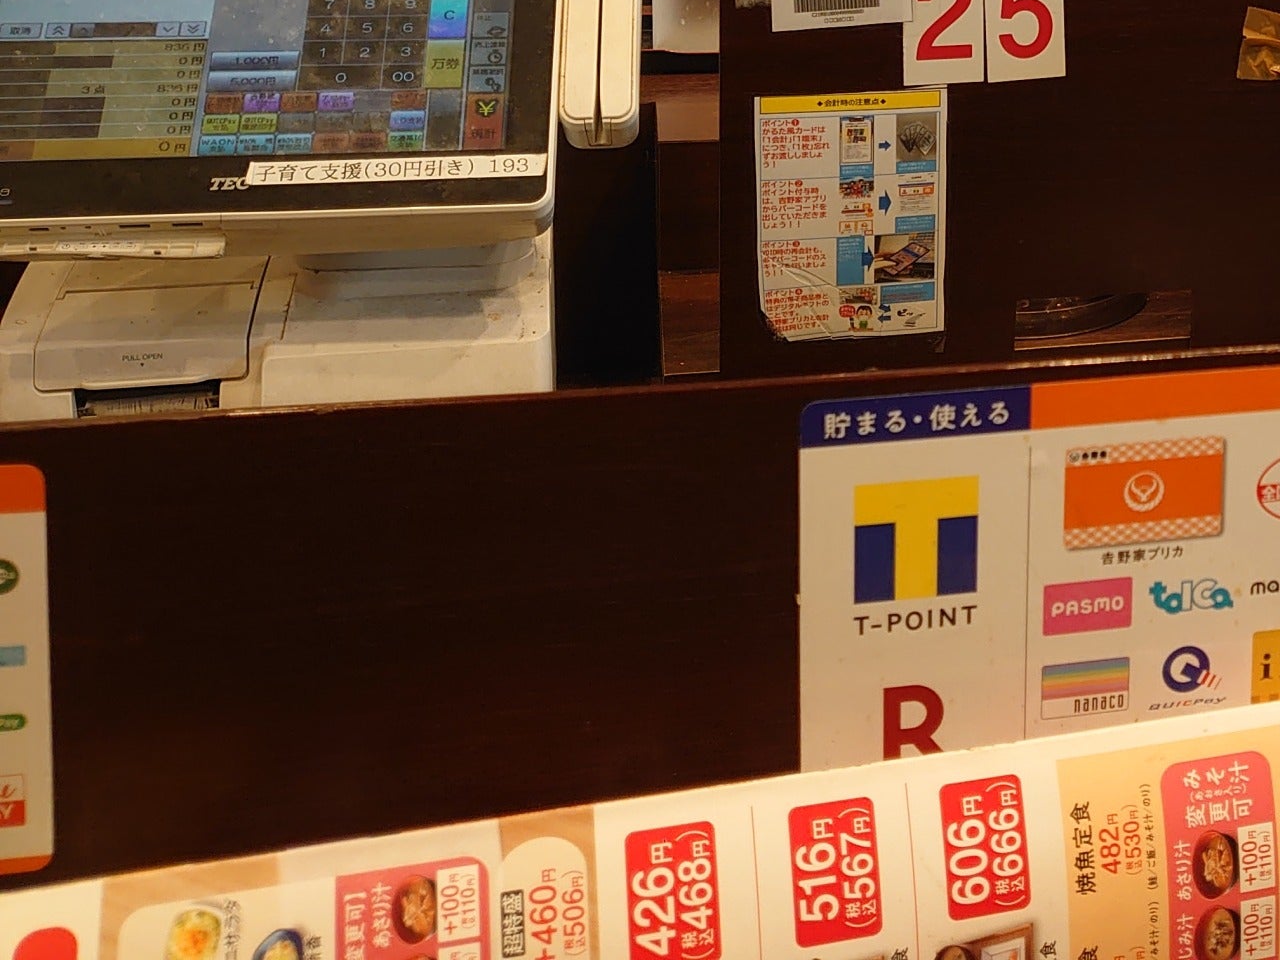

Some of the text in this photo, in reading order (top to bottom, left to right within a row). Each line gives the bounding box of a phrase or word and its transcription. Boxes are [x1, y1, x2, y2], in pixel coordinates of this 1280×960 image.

[319, 9, 456, 34] 4 5 6 C
[488, 157, 531, 174] 193
[823, 399, 1010, 440] 貯まる・使える
[1101, 544, 1185, 566] 吉野家プリカ
[853, 605, 978, 636] T-POINT
[1050, 594, 1125, 618] PASMO
[1073, 691, 1125, 713] nanaco
[1182, 760, 1250, 789] みそ汁
[1186, 797, 1254, 829] 変更可
[795, 817, 840, 923] 516円
[836, 805, 879, 930] (税込567円)
[946, 793, 990, 907] 606円
[985, 779, 1027, 908] (税込666円)
[1069, 800, 1098, 896] 焼魚定食
[1098, 813, 1122, 876] 482円
[1173, 839, 1194, 902] あさり汁
[1241, 827, 1258, 887] +100円
[440, 871, 462, 934] +100円
[631, 839, 679, 956] 426円
[1242, 903, 1260, 958] +100円
